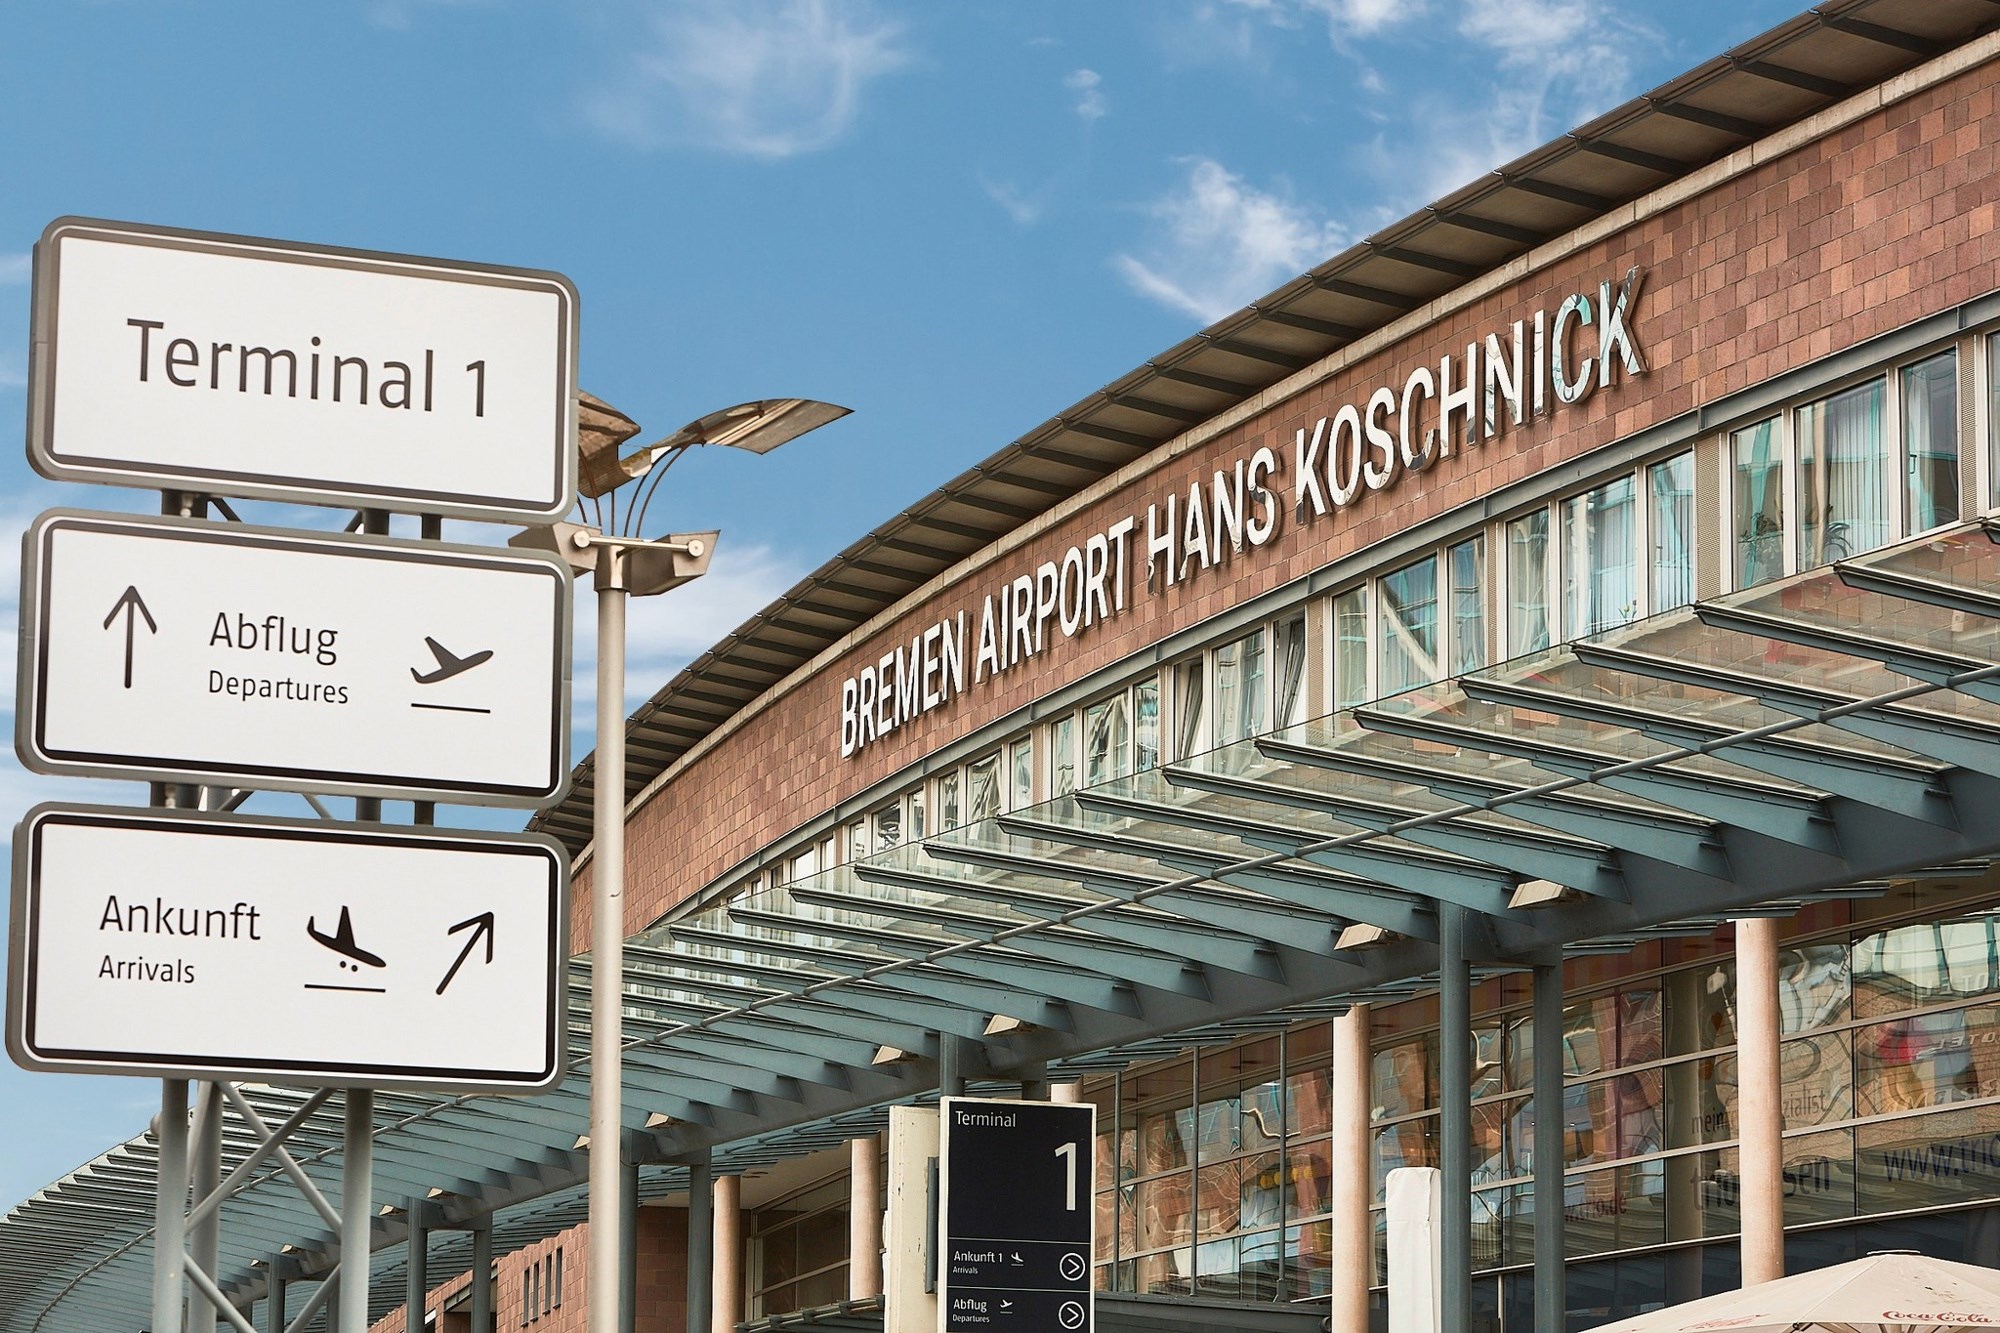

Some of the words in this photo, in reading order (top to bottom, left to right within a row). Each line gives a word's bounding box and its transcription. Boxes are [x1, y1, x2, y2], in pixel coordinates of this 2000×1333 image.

[127, 318, 434, 412] Terminal
[466, 360, 485, 417] 1
[841, 609, 964, 759] BREMEN
[975, 515, 1135, 684] AIRPORT
[1148, 446, 1278, 595] HANS
[1295, 265, 1646, 525] KOSCHNICK
[209, 611, 339, 666] Abflug
[209, 670, 348, 706] Departures
[100, 895, 261, 941] Ankunft
[99, 955, 195, 984] Arrivals
[955, 1110, 1016, 1128] Terminal
[1054, 1142, 1077, 1211] 1
[952, 1265, 979, 1275] Arrivals
[953, 1250, 996, 1263] Ankunft
[998, 1252, 1003, 1263] 1
[952, 1313, 990, 1323] Departures
[953, 1298, 988, 1313] Abflug
